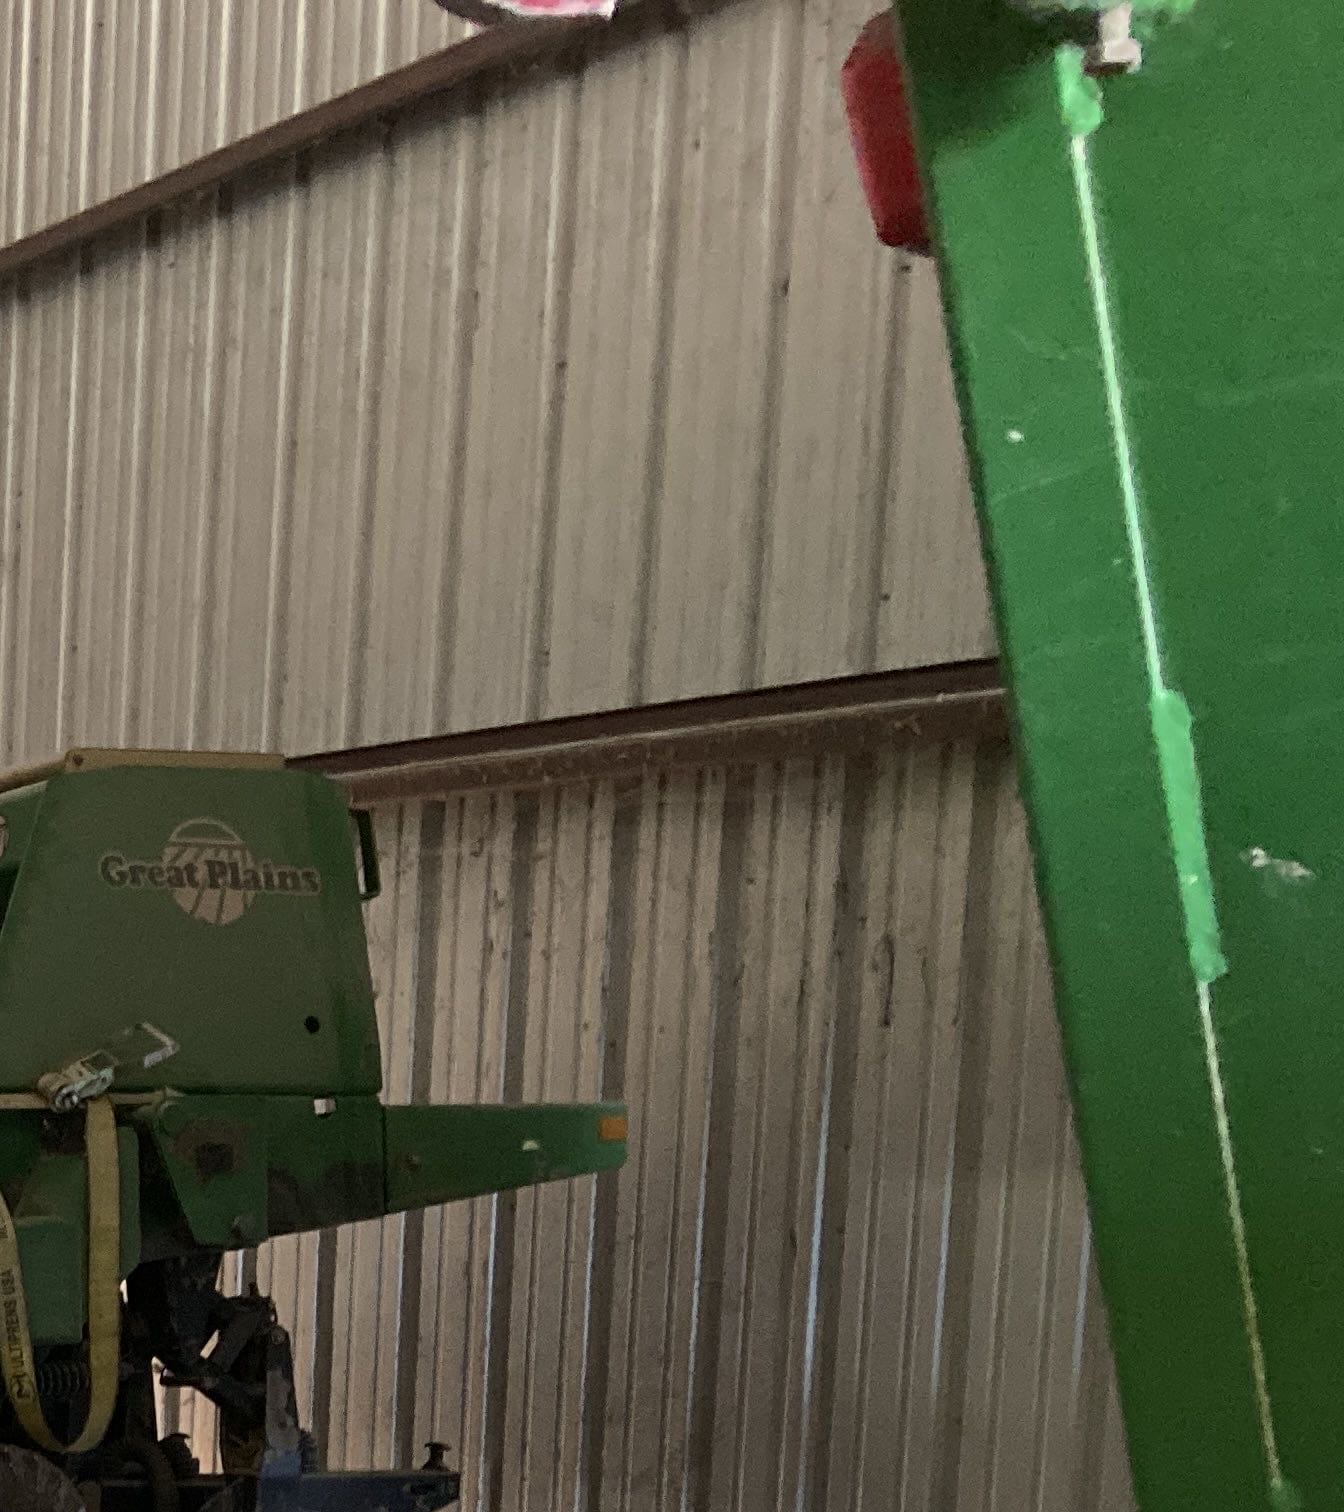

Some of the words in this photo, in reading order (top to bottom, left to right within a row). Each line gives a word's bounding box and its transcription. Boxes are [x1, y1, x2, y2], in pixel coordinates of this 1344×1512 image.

[100, 855, 199, 888] Great
[205, 860, 320, 892] Plains
[0, 1269, 15, 1295] USA
